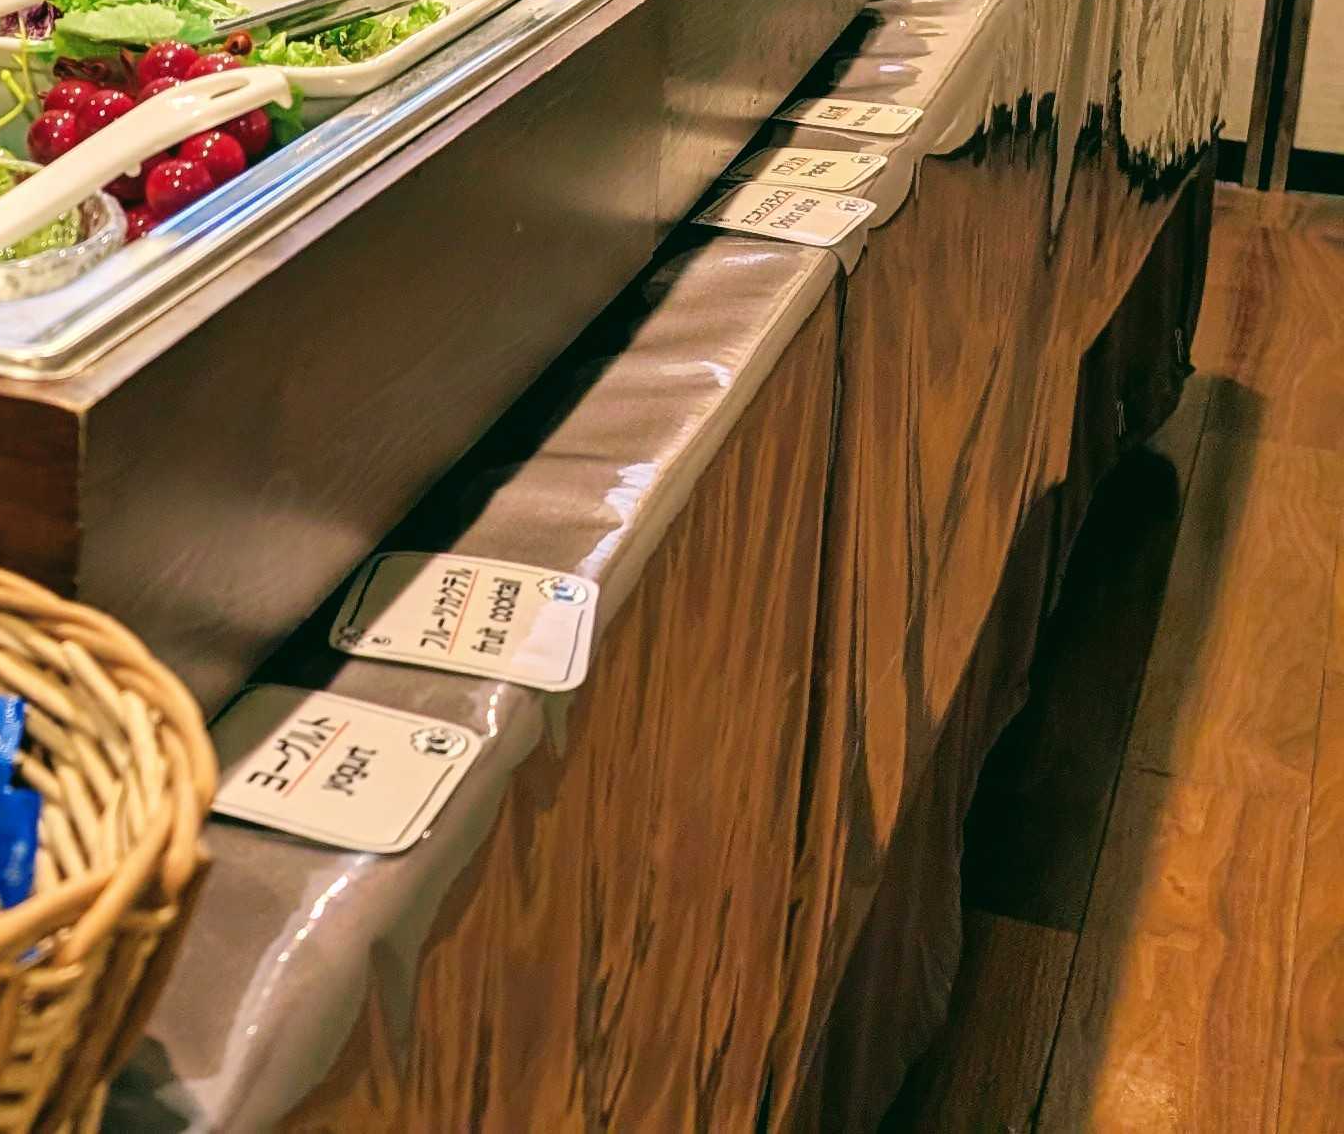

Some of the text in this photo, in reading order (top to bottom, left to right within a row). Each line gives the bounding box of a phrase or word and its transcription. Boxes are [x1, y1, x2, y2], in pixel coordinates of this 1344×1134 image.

[419, 567, 473, 650] フルーツカクテル
[471, 626, 509, 657] fruit
[246, 716, 339, 792] ヨーグルト
[320, 745, 379, 797] yogurt
